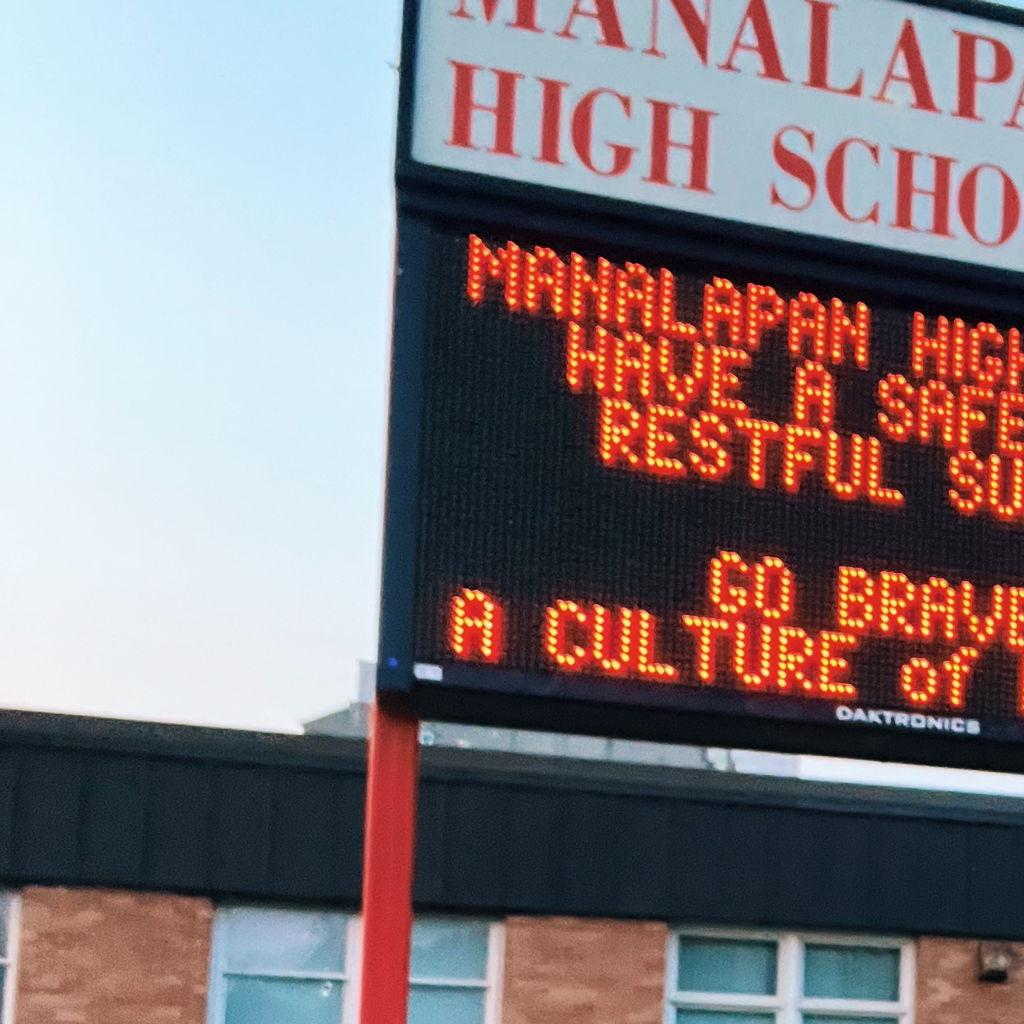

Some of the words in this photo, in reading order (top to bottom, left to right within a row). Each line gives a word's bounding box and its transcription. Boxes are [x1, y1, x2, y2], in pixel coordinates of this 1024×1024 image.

[444, 60, 719, 195] HIGH
[467, 234, 870, 369] MANALAPAN
[566, 321, 750, 416] HAVE
[794, 360, 835, 430] A
[600, 396, 904, 505] RESTFUL
[709, 550, 794, 620] GO
[450, 588, 503, 662] A
[545, 599, 857, 698] CULTURE
[899, 645, 978, 709] of
[835, 705, 981, 735] DAKTRONICS
